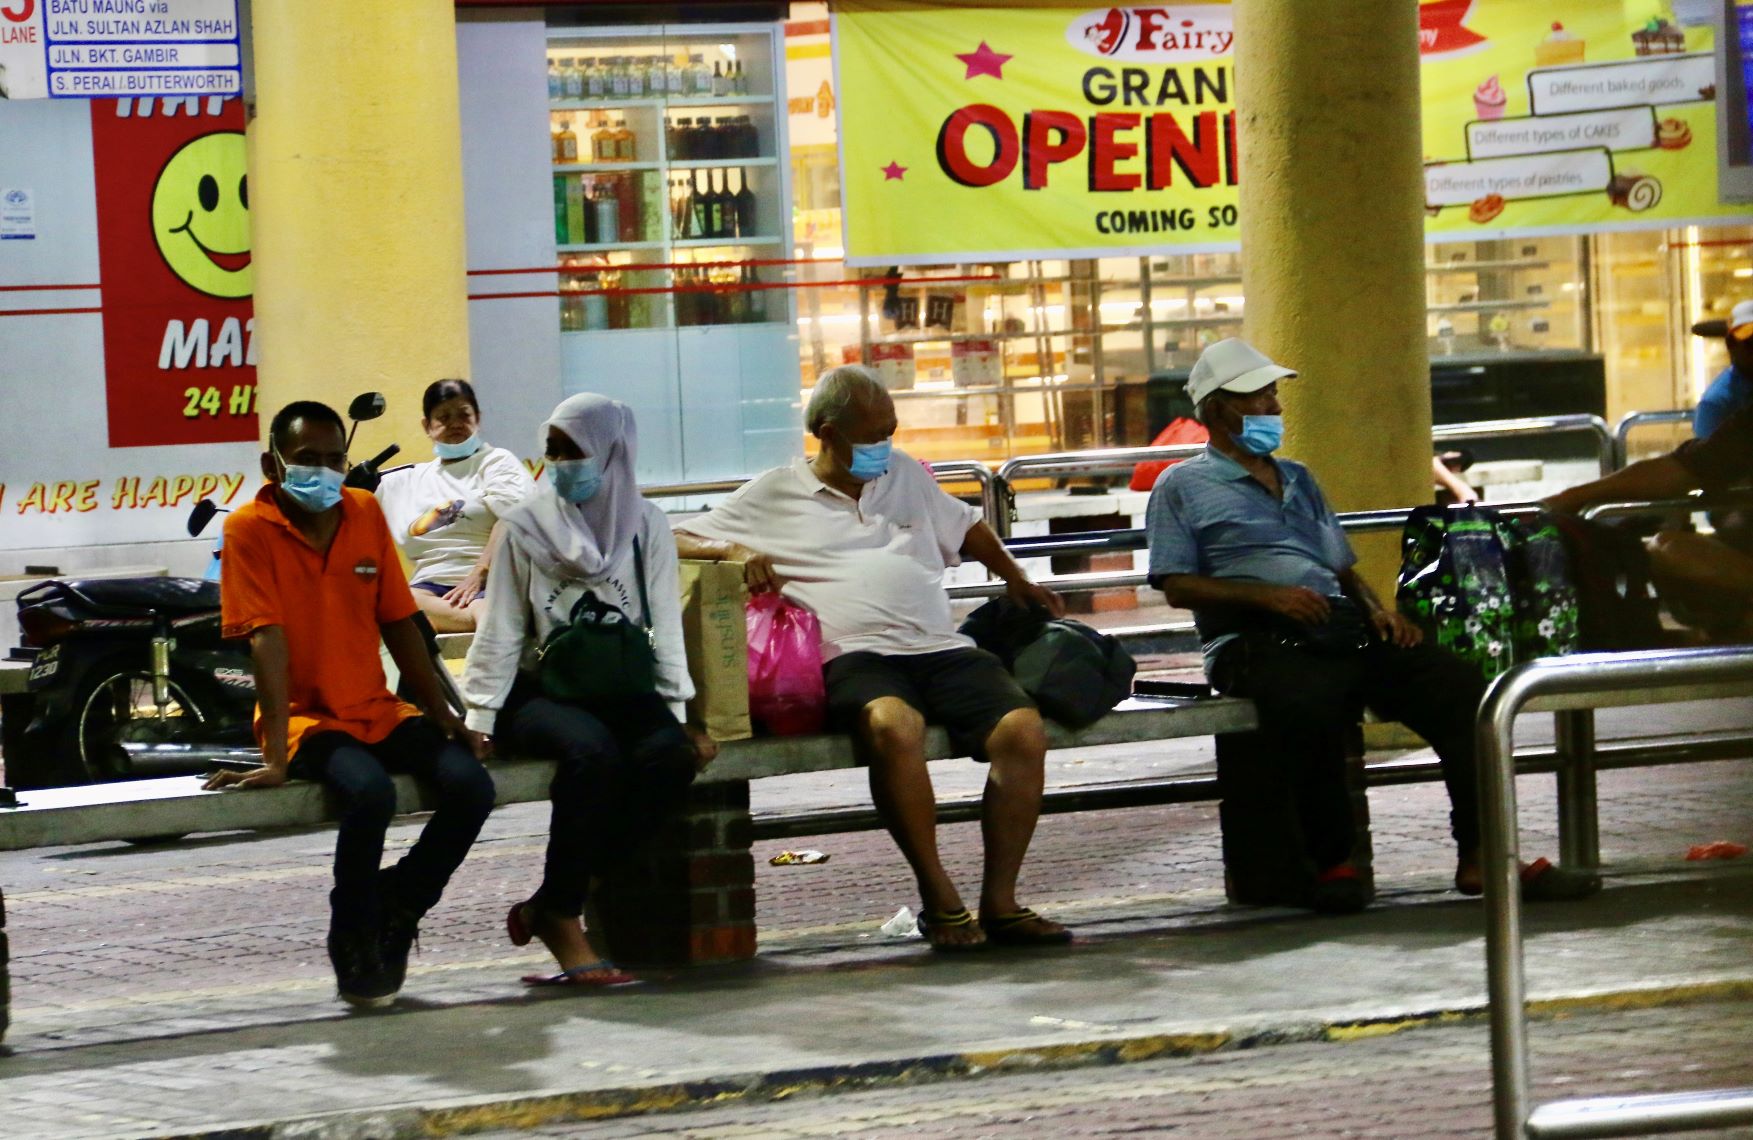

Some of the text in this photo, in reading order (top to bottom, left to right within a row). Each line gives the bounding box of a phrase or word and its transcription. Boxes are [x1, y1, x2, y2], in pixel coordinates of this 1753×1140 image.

[51, 0, 169, 14] BATU MAUNG via
[2, 26, 37, 44] LANE
[52, 19, 233, 35] JLN. SULTAN AZLAN SHAH
[1134, 9, 1233, 54] Fairy
[54, 48, 179, 64] JLN. BKT. GAMBIR
[56, 76, 70, 91] S.
[73, 76, 115, 90] PERAI
[127, 74, 234, 90] BUTTERWORTH
[1081, 67, 1236, 106] GRAN
[1549, 76, 1685, 96] Different baked goods
[1474, 122, 1620, 145] Different types of CAKES
[1430, 171, 1583, 193] Different types of pastries
[1096, 208, 1195, 234] COMING
[182, 386, 222, 417] 24
[18, 479, 99, 514] ARE
[112, 472, 244, 509] HAPPY
